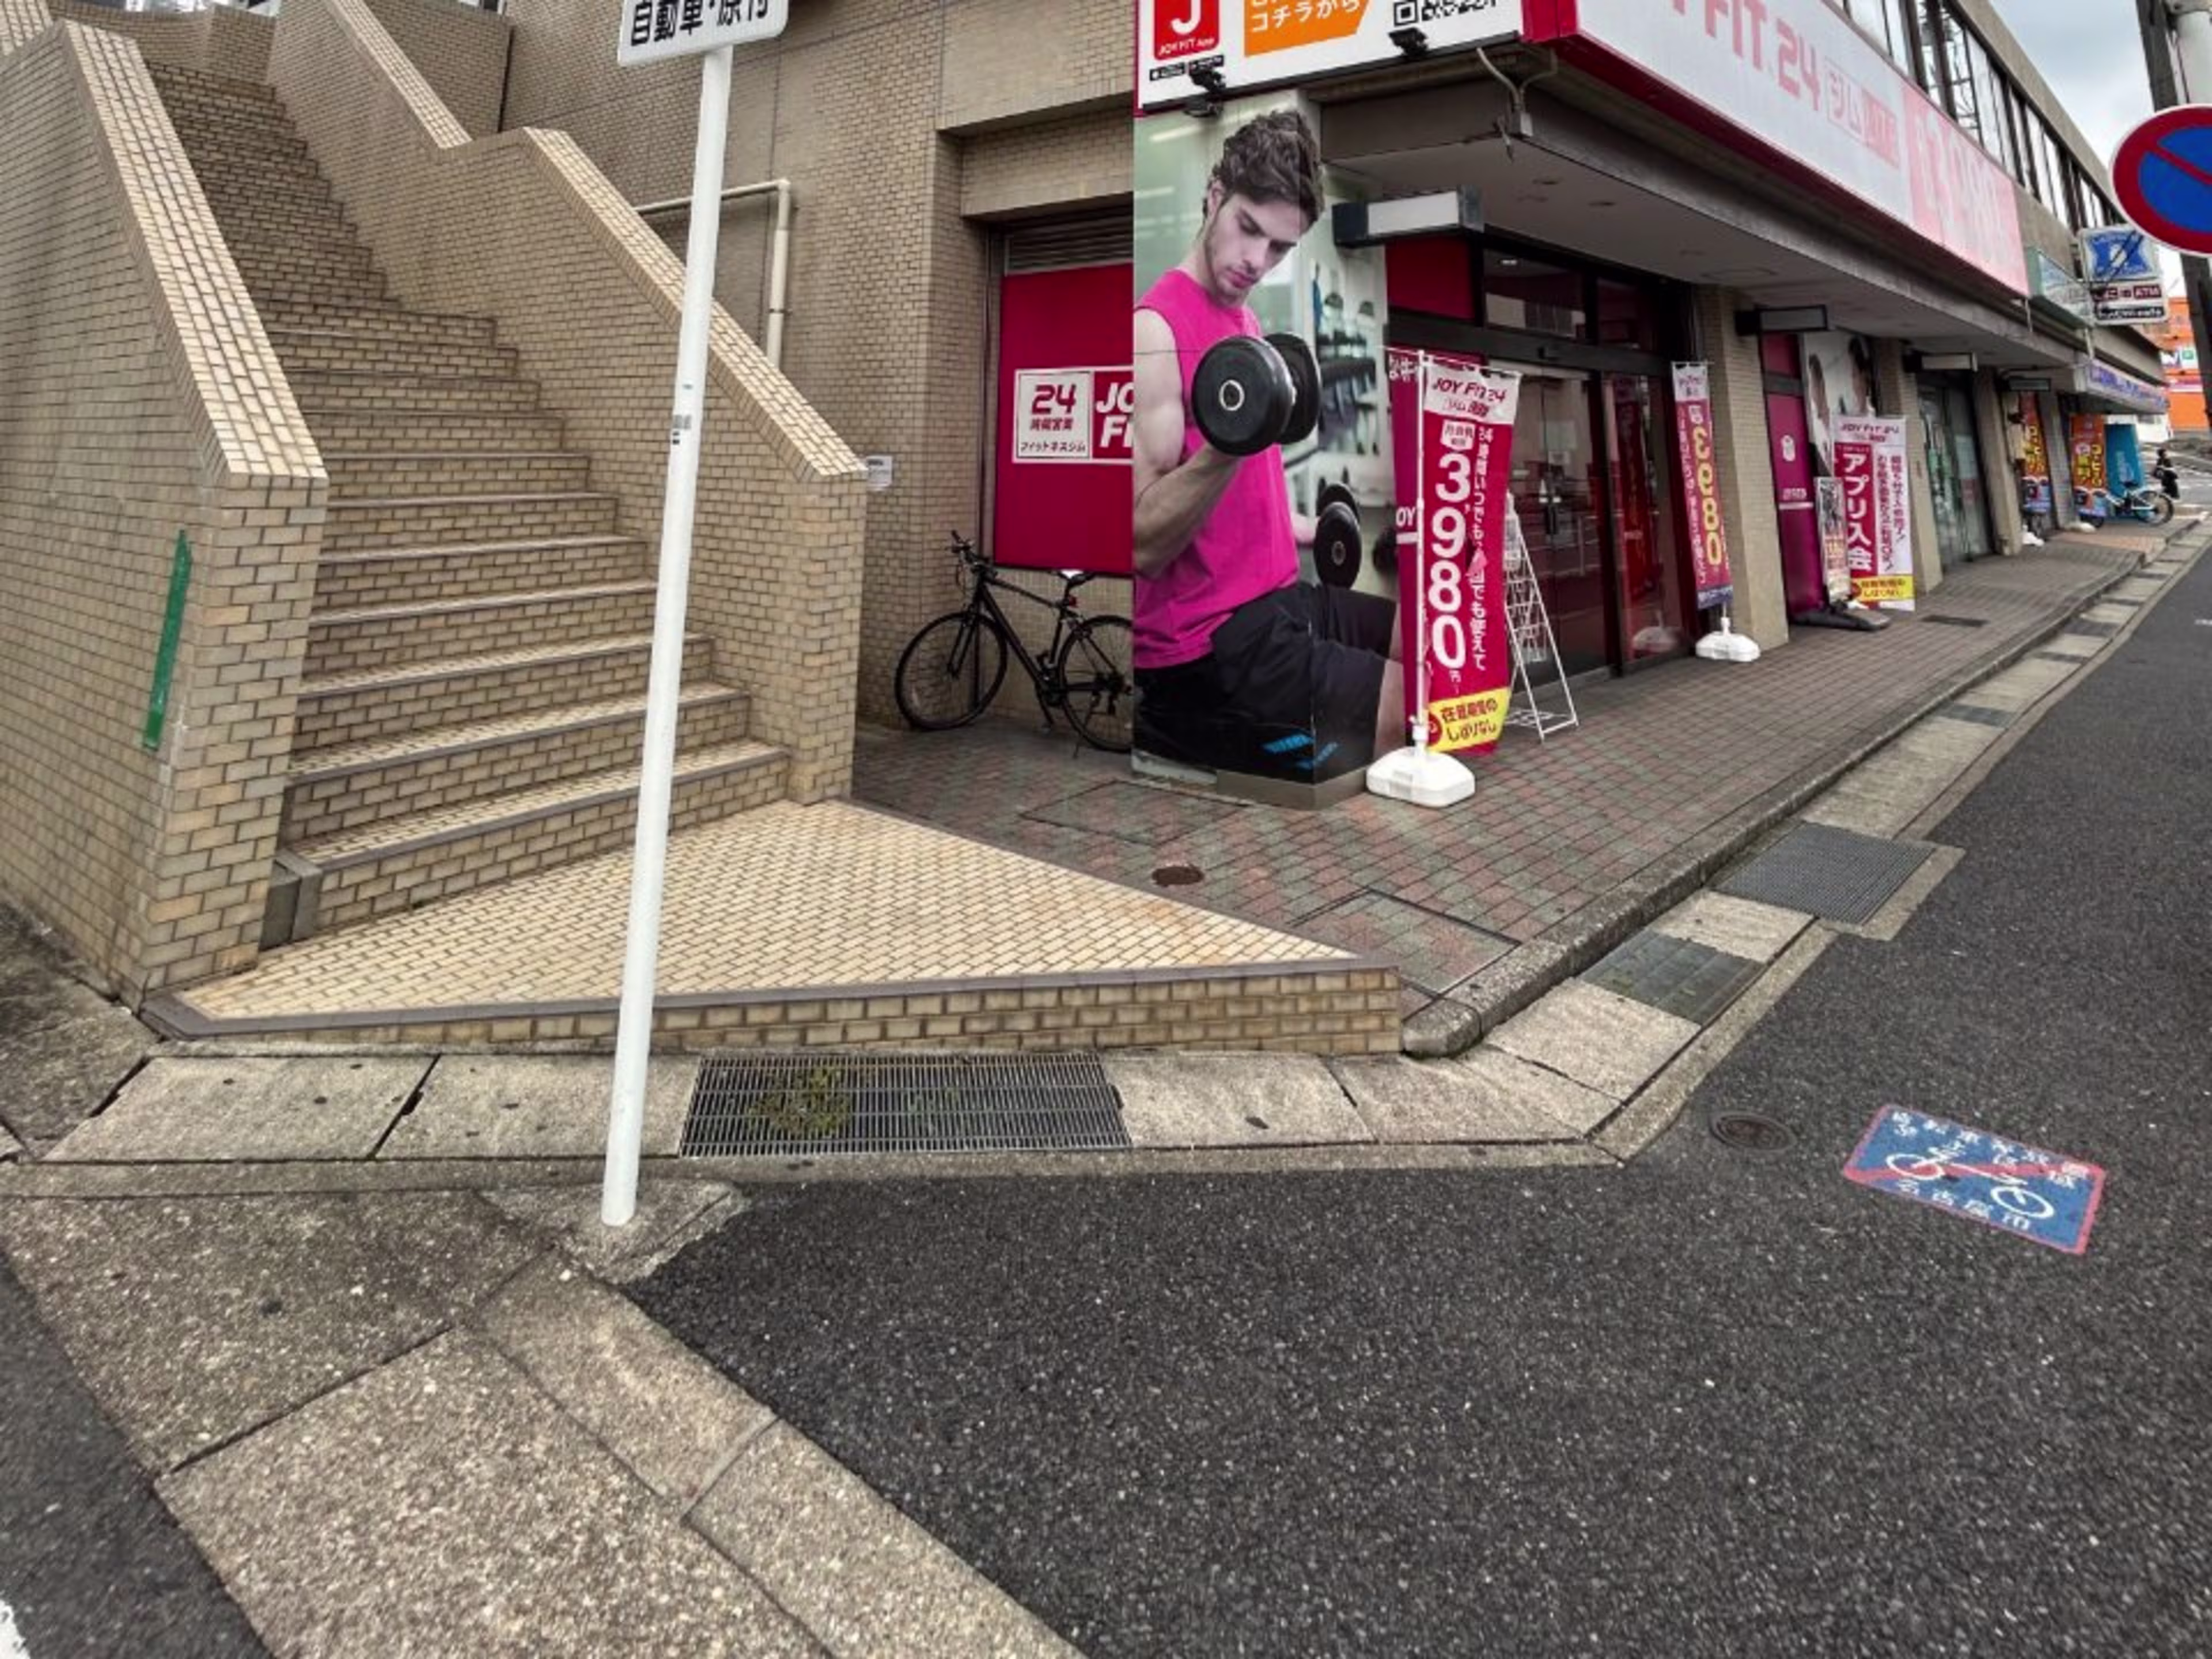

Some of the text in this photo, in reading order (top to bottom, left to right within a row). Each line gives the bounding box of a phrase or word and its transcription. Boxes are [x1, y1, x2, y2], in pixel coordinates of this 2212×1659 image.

[1252, 0, 1361, 33] コチラから
[1032, 384, 1077, 415] 24
[1096, 382, 1133, 414] JO
[1100, 415, 1133, 448] FI
[1843, 452, 1873, 571] アプリ入会
